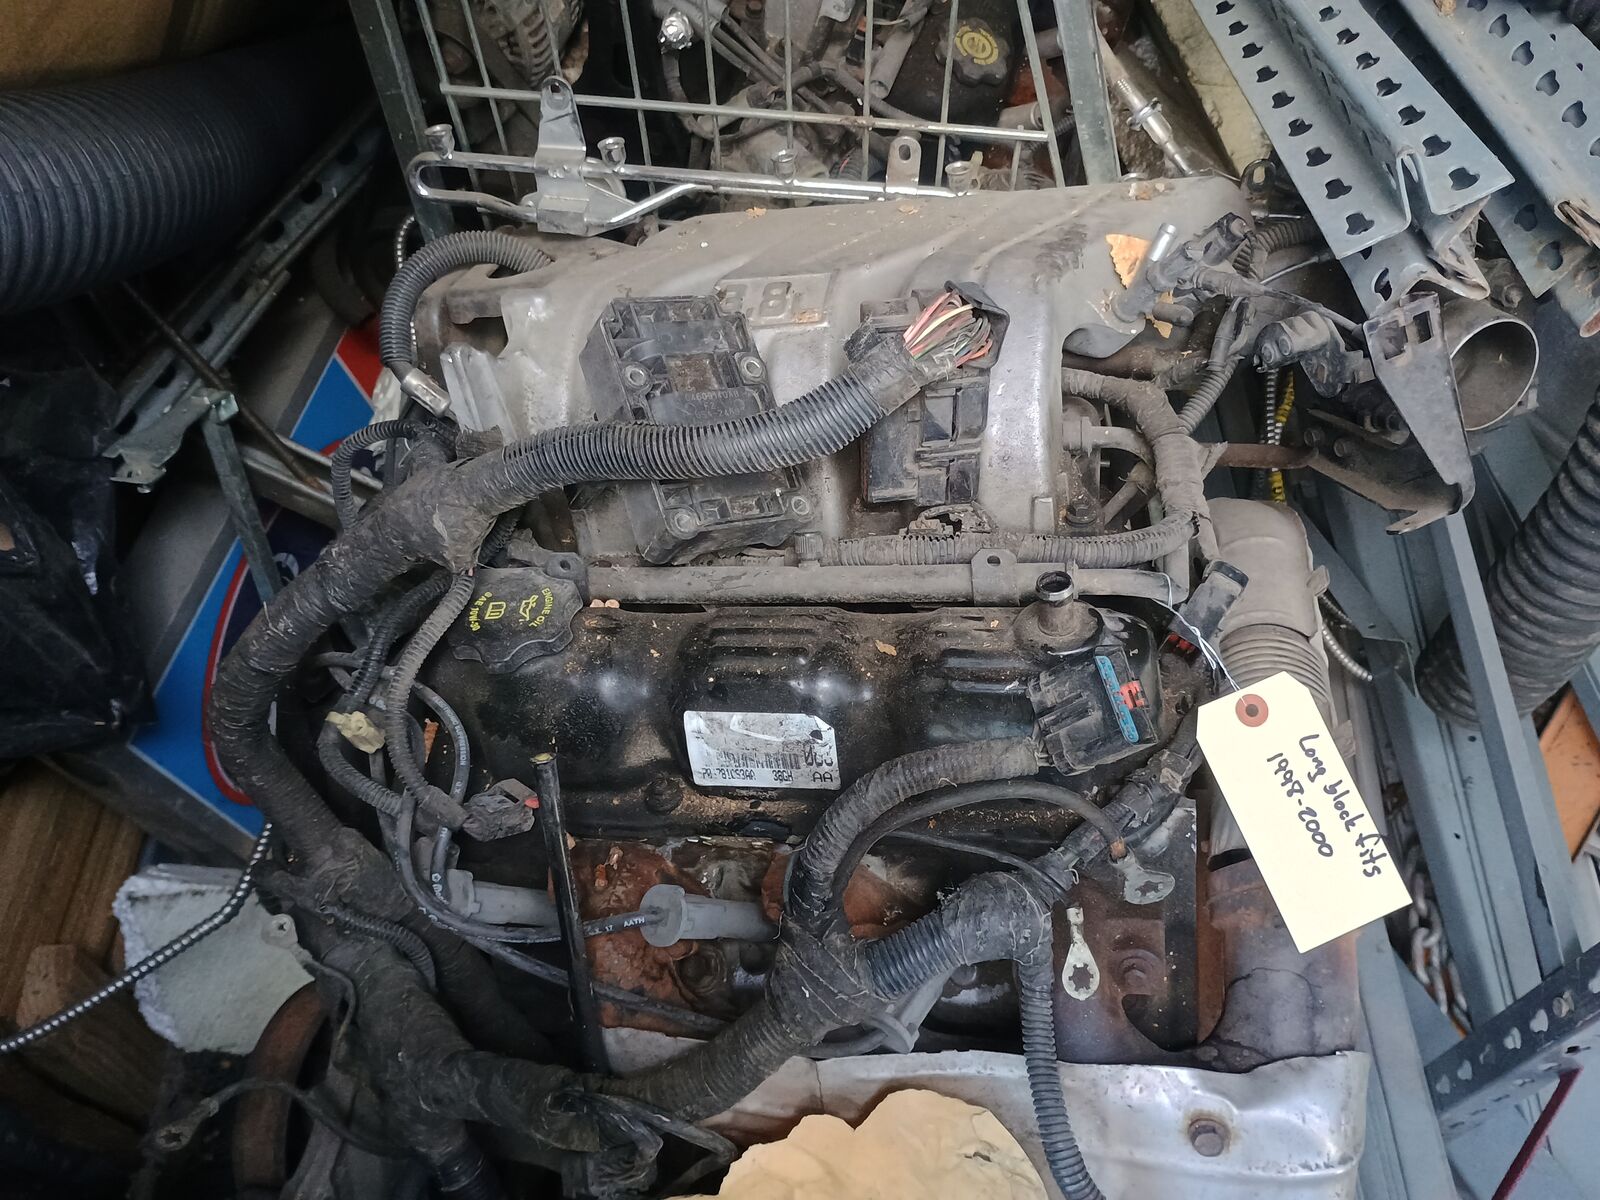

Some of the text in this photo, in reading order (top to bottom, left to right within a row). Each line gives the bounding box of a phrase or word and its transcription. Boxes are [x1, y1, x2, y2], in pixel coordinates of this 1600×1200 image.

[474, 591, 493, 607] SAE
[528, 587, 554, 628] ENGINE OIL
[812, 771, 833, 783] AA
[1266, 752, 1334, 858] 1998-2000
[1298, 734, 1388, 878] Long block fits
